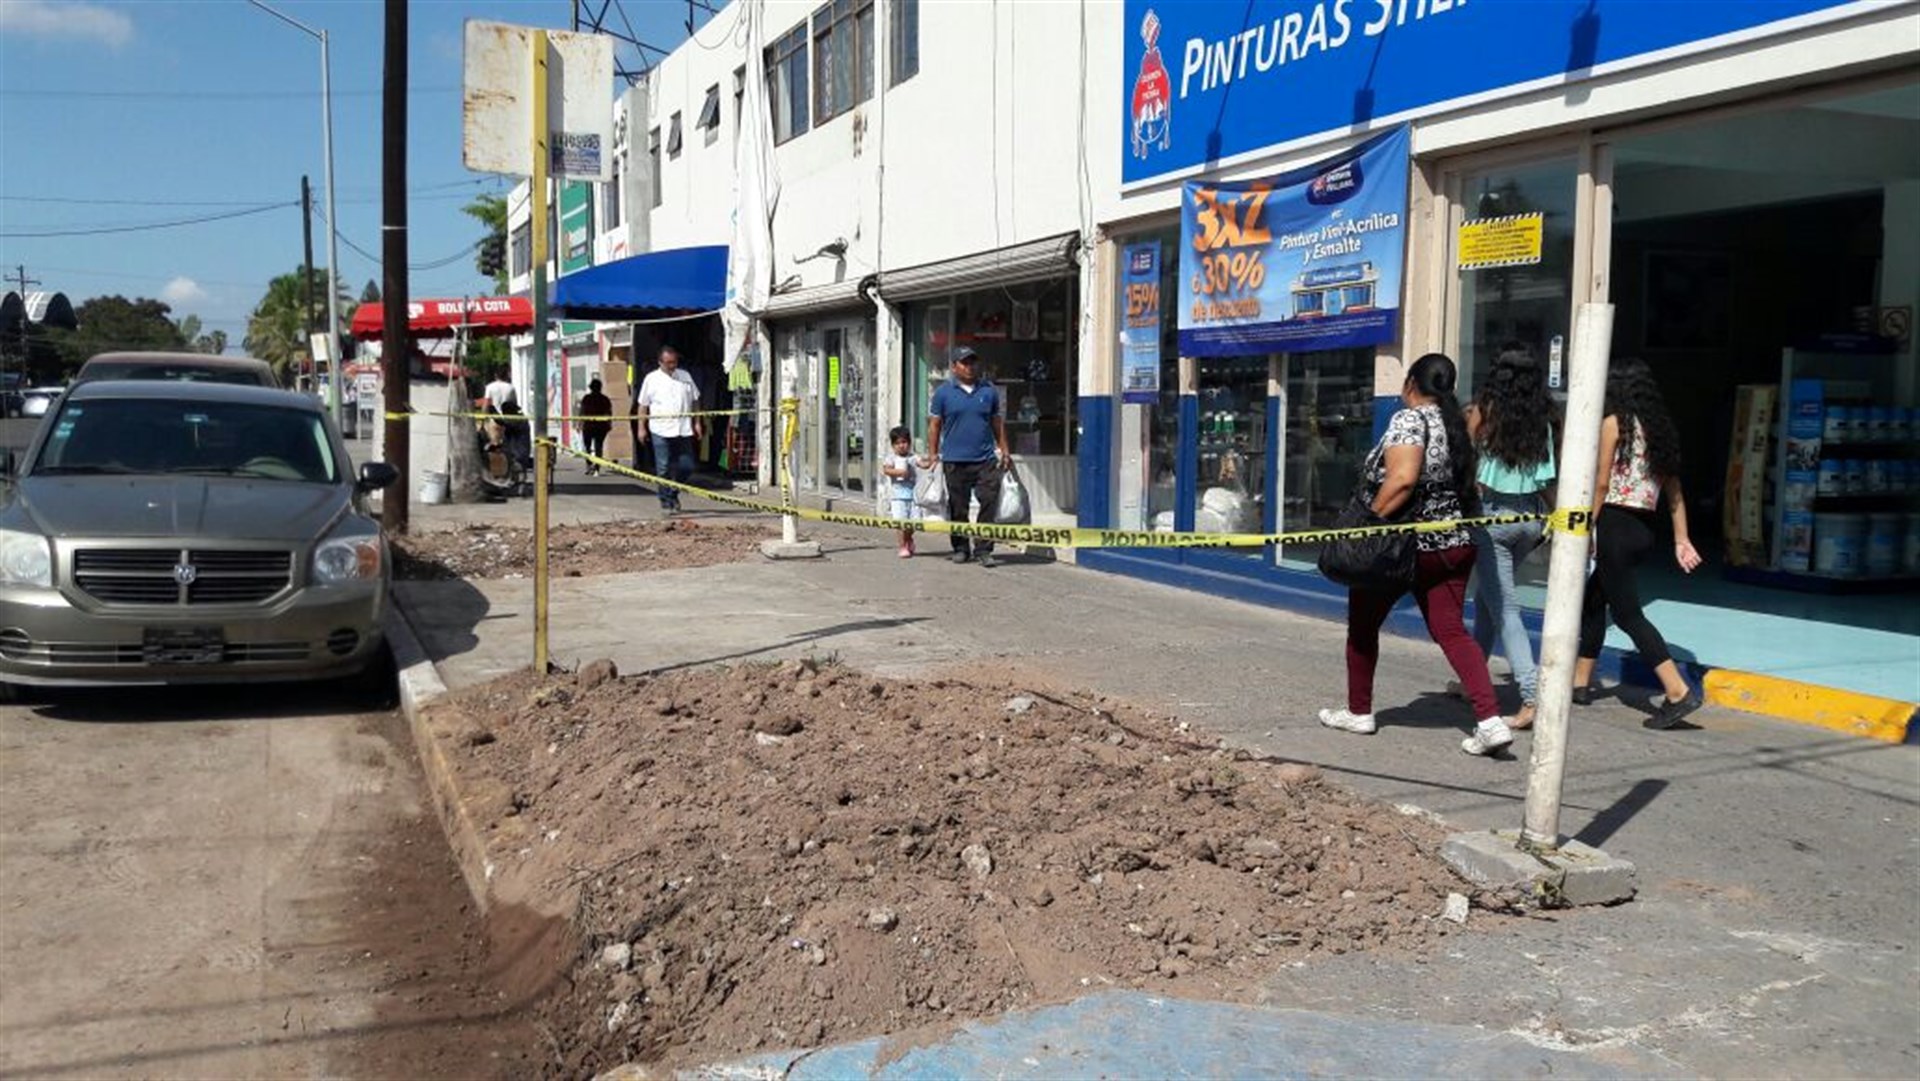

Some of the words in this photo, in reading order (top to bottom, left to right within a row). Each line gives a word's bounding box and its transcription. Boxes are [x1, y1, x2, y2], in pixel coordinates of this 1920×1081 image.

[1180, 1, 1349, 98] PINTURAS
[1314, 238, 1361, 259] Esmalte
[1202, 251, 1265, 295] 30%
[484, 301, 511, 313] COTA
